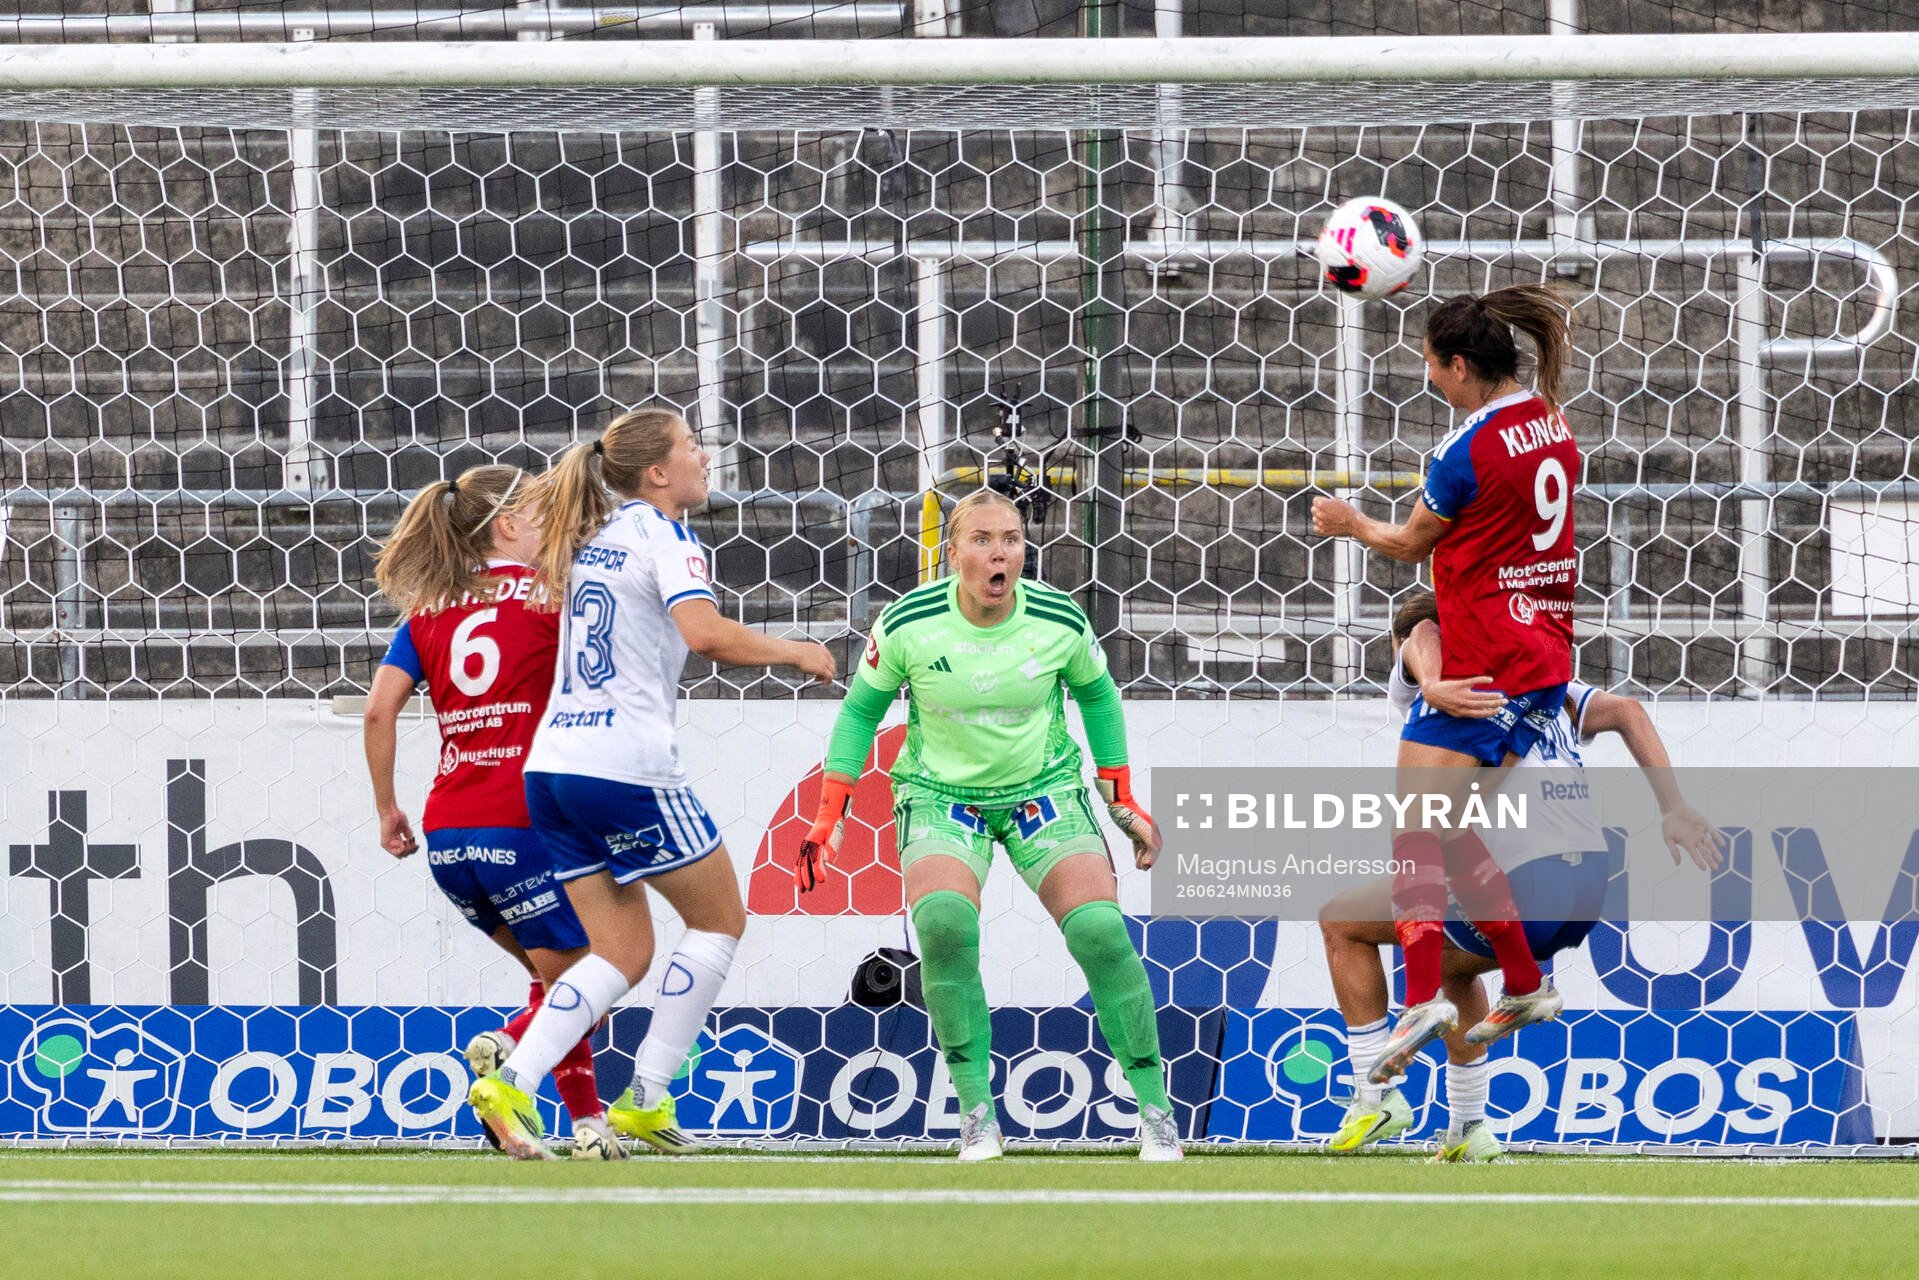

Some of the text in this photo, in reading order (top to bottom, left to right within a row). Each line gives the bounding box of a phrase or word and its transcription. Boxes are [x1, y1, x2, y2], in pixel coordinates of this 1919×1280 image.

[1499, 412, 1572, 457] KLINGA
[1532, 457, 1568, 551] 9
[1555, 572, 1569, 584] AB
[450, 607, 500, 697] 6
[561, 580, 617, 694] 13
[486, 717, 503, 728] AB
[210, 1051, 482, 1131] OBO
[1484, 1057, 1799, 1135] OBOS
